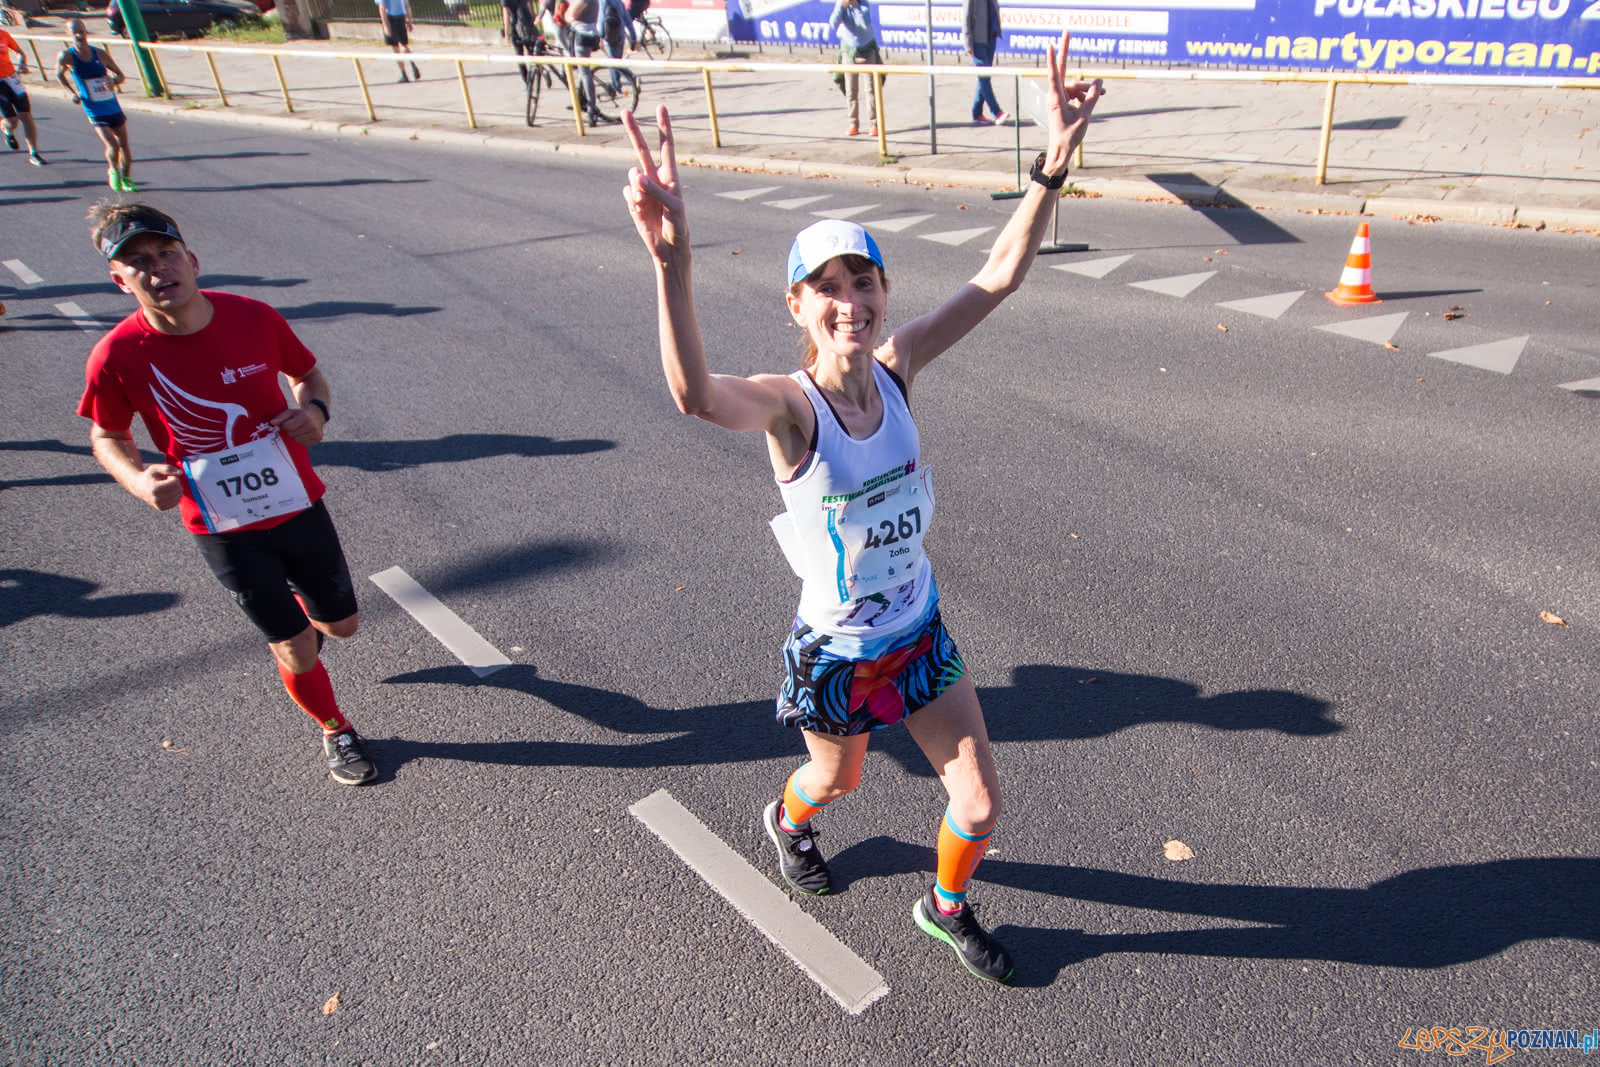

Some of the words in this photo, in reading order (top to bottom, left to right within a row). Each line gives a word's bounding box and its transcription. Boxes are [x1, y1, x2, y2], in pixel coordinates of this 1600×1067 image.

[1068, 15, 1132, 28] MODELE
[1118, 40, 1168, 56] SERWIS
[216, 467, 279, 497] 1708
[241, 493, 269, 504] Tomasz
[864, 507, 922, 549] 4267
[889, 546, 910, 558] Zofia
